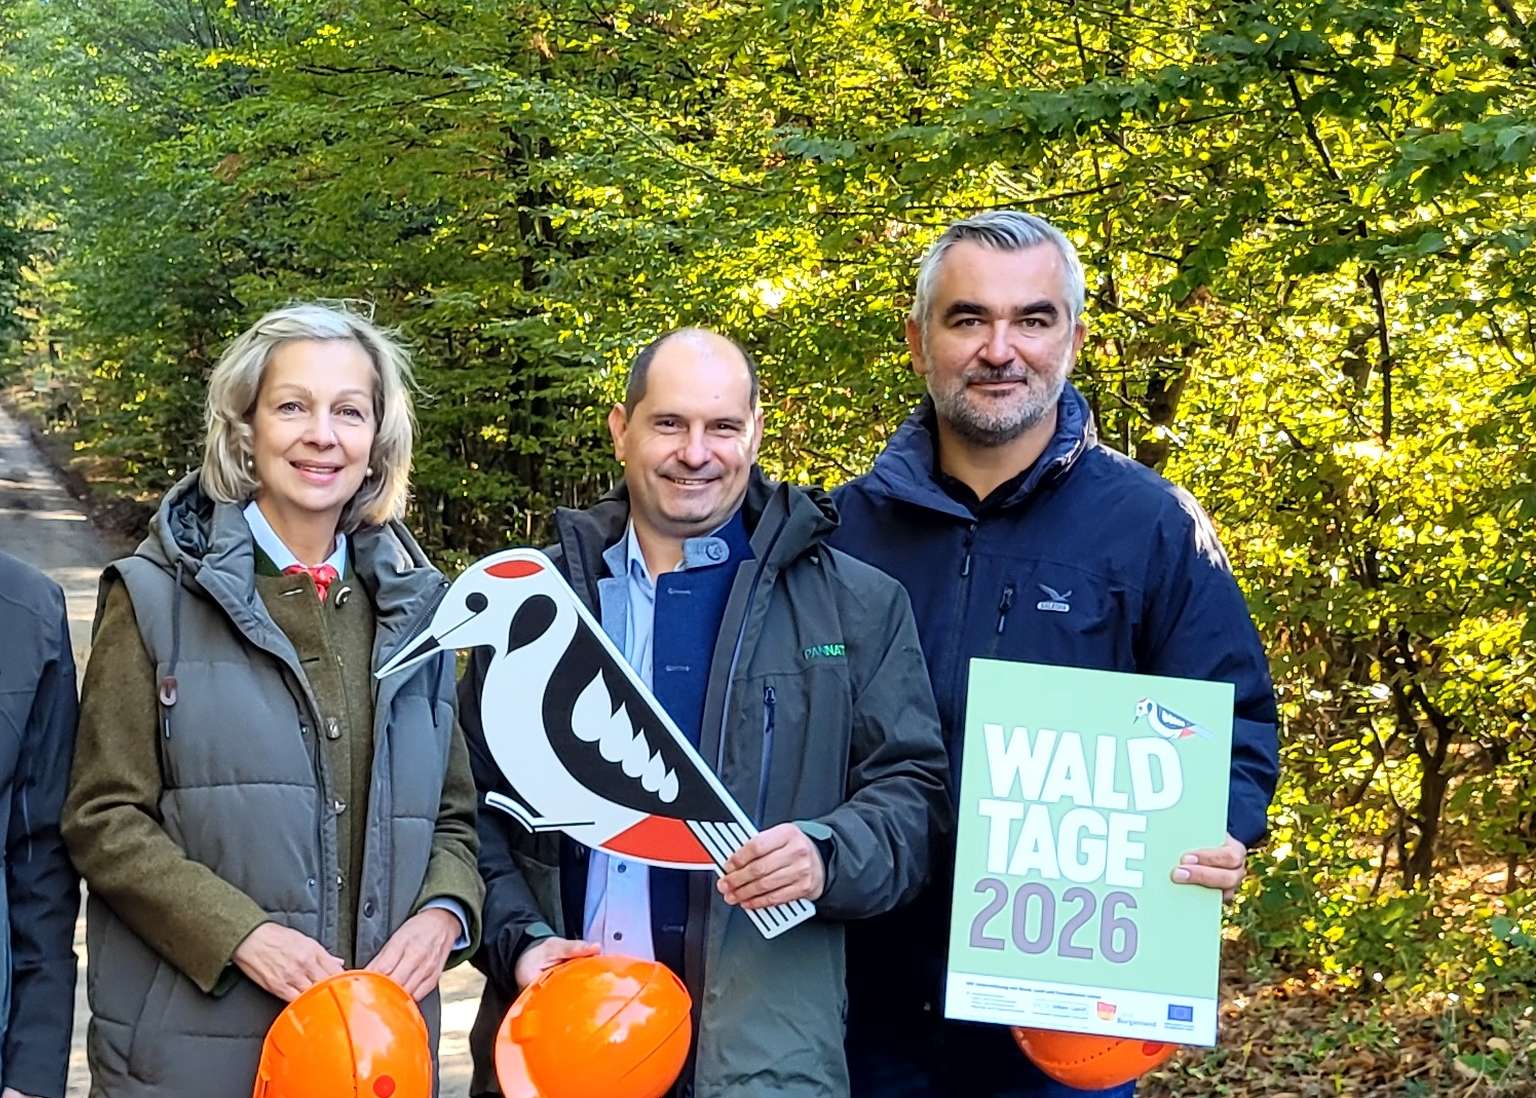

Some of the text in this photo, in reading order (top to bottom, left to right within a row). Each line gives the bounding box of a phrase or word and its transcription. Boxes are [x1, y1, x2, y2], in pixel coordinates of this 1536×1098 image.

[983, 723, 1184, 811] WALD
[977, 798, 1148, 888] TAGE
[968, 877, 1139, 964] 2026
